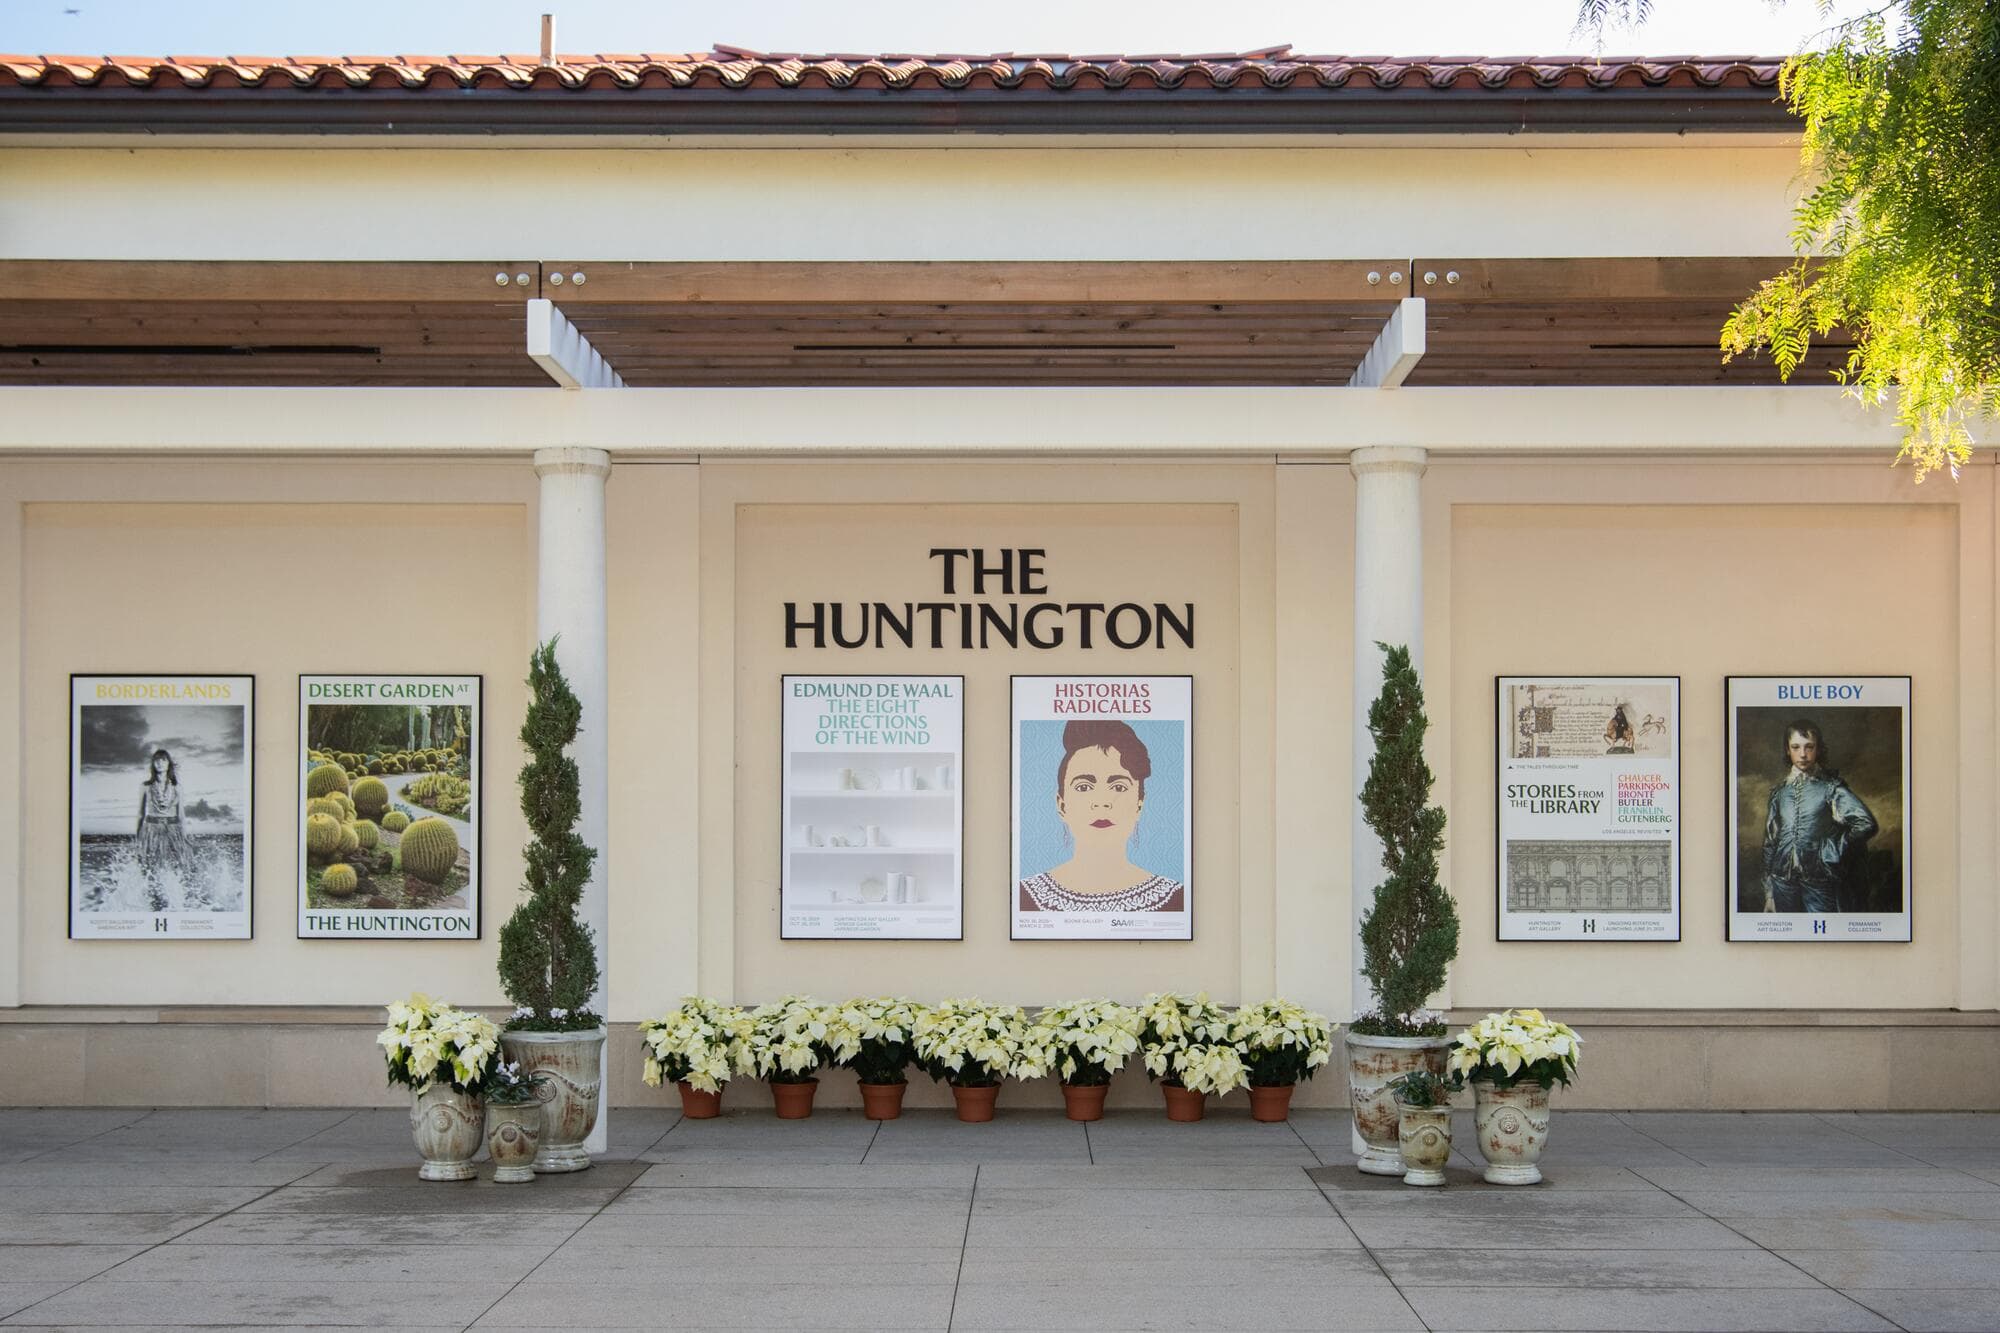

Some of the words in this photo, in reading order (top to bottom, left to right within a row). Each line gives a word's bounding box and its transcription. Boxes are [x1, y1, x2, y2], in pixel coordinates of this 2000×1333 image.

[929, 548, 1048, 595] THE
[783, 602, 1195, 649] HUNTINGTON
[96, 683, 231, 699] BORDERLANDS
[309, 683, 376, 698] DESERT
[380, 683, 455, 698] GARDEN
[456, 684, 469, 693] AT
[793, 683, 873, 698] EDMUND
[876, 683, 898, 698] DE
[901, 683, 953, 698] WAAL
[1055, 683, 1150, 698] HISTORIAS
[1777, 685, 1823, 700] BLUE
[1827, 685, 1864, 700] BOY
[826, 699, 863, 713] THE
[865, 699, 920, 713] EIGHT
[1053, 699, 1152, 713] RADICALES
[818, 715, 928, 729] DIRECTIONS
[815, 730, 840, 745] OF
[843, 730, 878, 745] THE
[882, 730, 930, 745] WIND
[1618, 774, 1662, 783] CHAUCER
[1507, 784, 1577, 799] STORIES
[1578, 790, 1604, 798] FROM
[1618, 782, 1670, 791] PARKINSON
[1511, 799, 1529, 808] THE
[1530, 800, 1601, 814] LIBRARY
[1618, 798, 1653, 807] BUTLER
[1618, 806, 1663, 815] FRANKLIN
[1618, 814, 1672, 823] GUTENBERG
[307, 915, 342, 931] THE
[346, 915, 471, 932] HUNTINGTON
